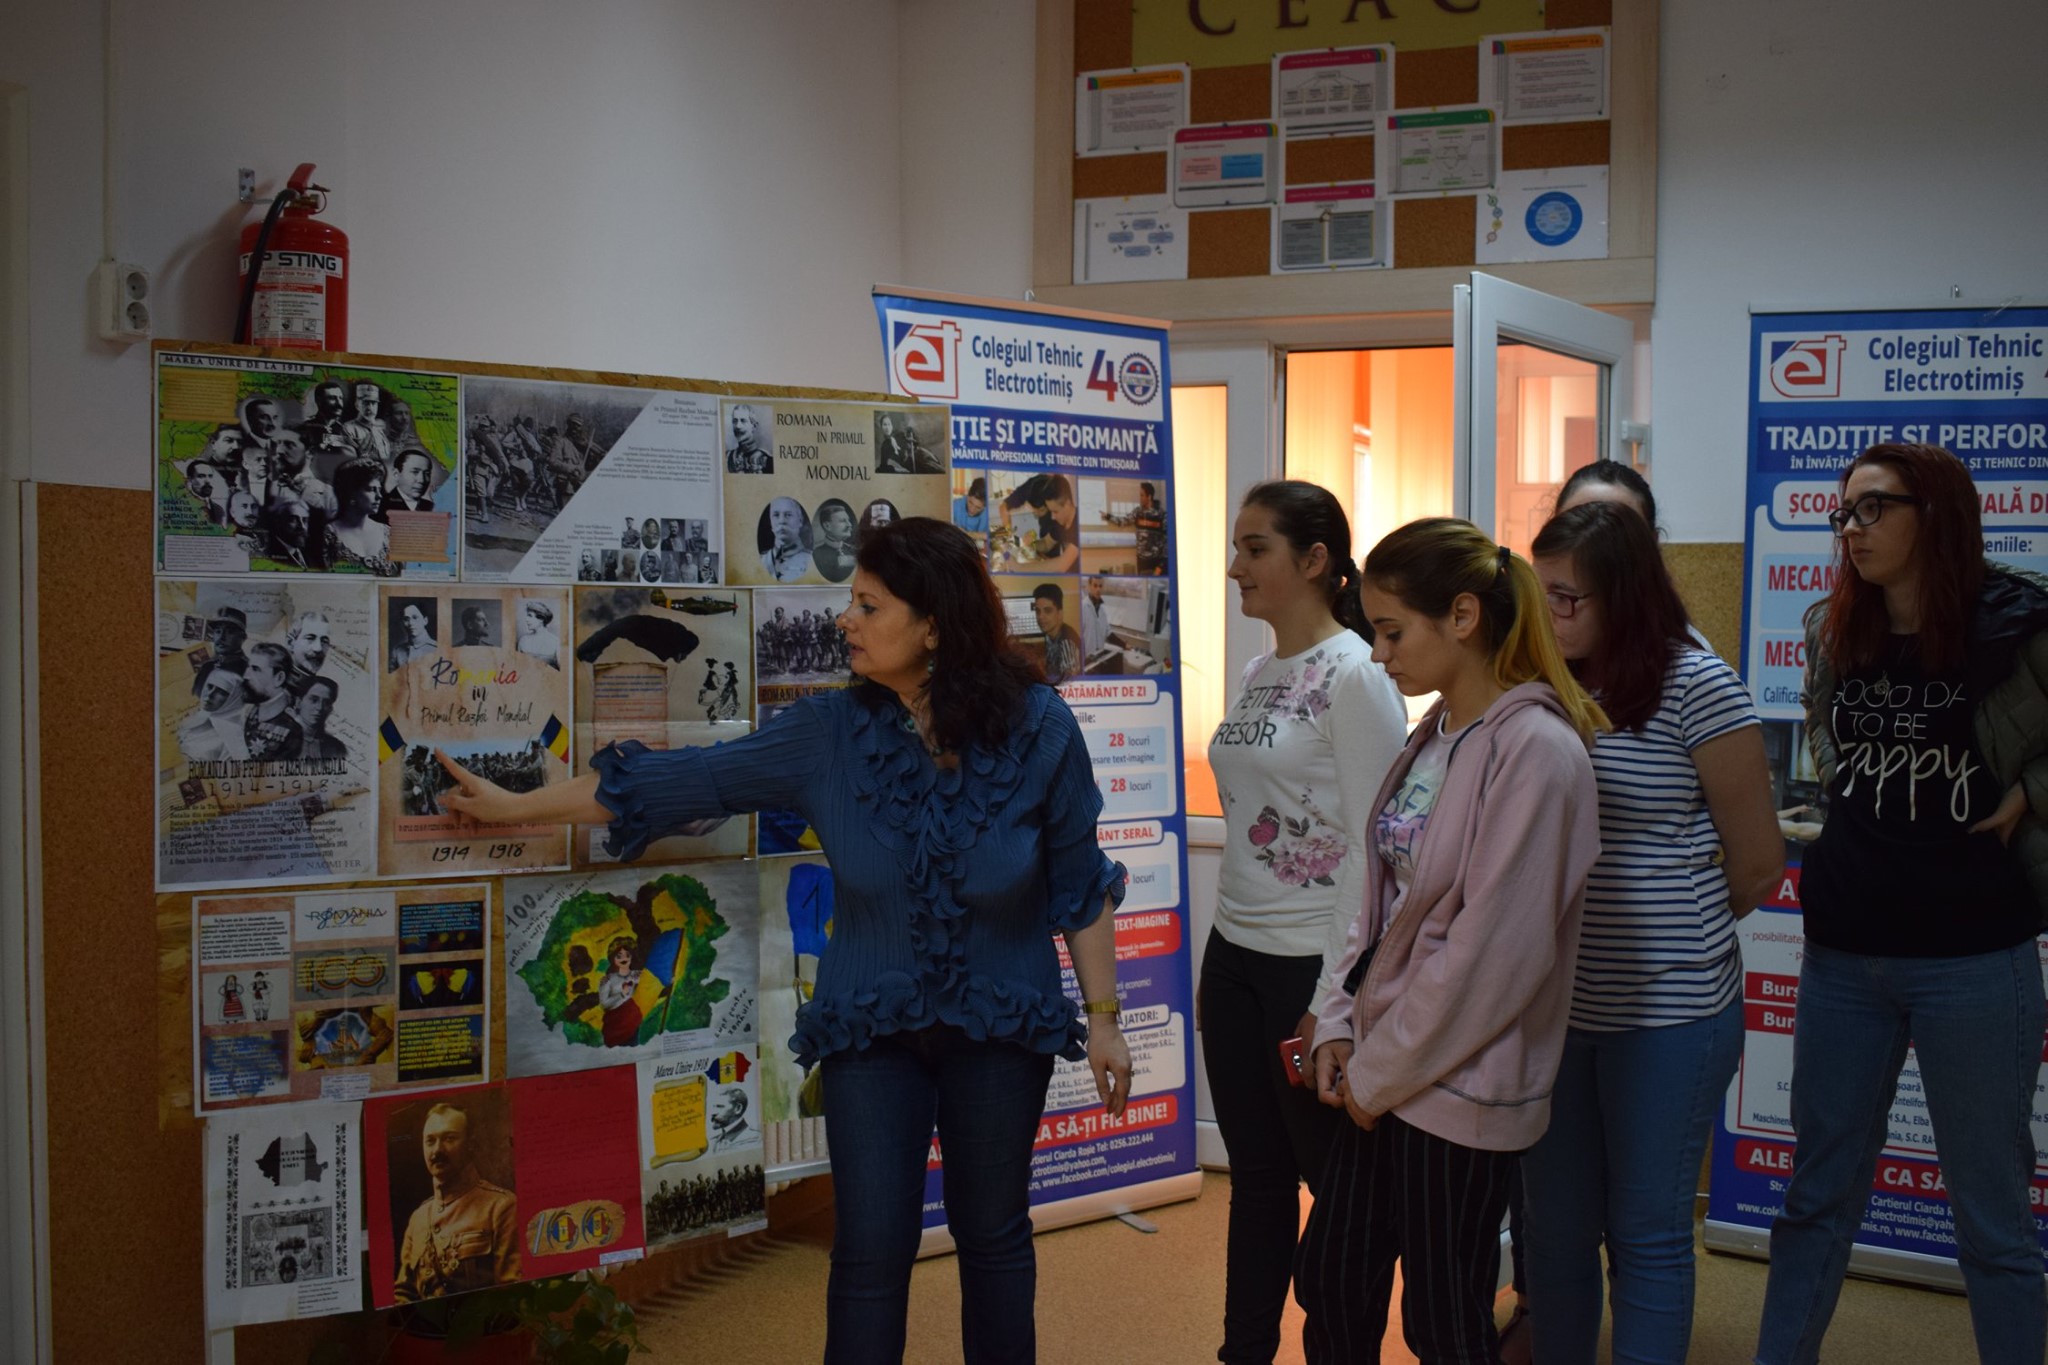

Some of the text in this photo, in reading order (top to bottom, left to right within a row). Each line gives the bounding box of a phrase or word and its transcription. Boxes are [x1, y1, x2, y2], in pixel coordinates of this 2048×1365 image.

[243, 252, 336, 271] TP STING
[972, 335, 1083, 368] Colegiul Tehnic
[1868, 333, 2043, 366] Colegiul Tehnic
[165, 355, 203, 366] MAREA
[246, 361, 260, 369] DE
[264, 362, 277, 370] LA
[985, 368, 1074, 404] Electrotimiș
[1884, 366, 2024, 396] Electrotimiș
[776, 413, 833, 427] ROMANIA
[816, 432, 865, 445] IN PRIMUL
[996, 418, 1016, 449] ȘI
[1020, 420, 1159, 460] PERFORMANȚĂ
[779, 445, 818, 460] RAZBOI
[990, 449, 1044, 464] PROFESIONAL
[1056, 454, 1082, 467] TEHNIC
[1083, 456, 1098, 468] DIN
[1790, 454, 1804, 470] ÎN
[1983, 456, 2026, 469] TEHNIC
[806, 465, 871, 481] MONDIAL
[1122, 686, 1134, 697] DE
[1137, 686, 1147, 696] ZI
[1848, 711, 1928, 740] TO BE
[1109, 733, 1150, 747] 28 locuri
[1113, 754, 1155, 765] text-imagine
[1110, 778, 1152, 792] 28 locuri
[1123, 827, 1155, 840] SERAL
[432, 842, 526, 862] 1914 1918
[1132, 872, 1155, 884] locuri
[505, 894, 536, 928] 100
[1114, 913, 1170, 932] TEXT-IMAGINE
[1056, 1115, 1096, 1138] SĂ-ȚI
[1128, 1102, 1168, 1126] BINE!
[1054, 1150, 1077, 1162] Ciarda
[1749, 1148, 1794, 1170] ALE
[1883, 1166, 1914, 1188] CA
[1871, 1195, 1944, 1216] Cartierul Ciarda
